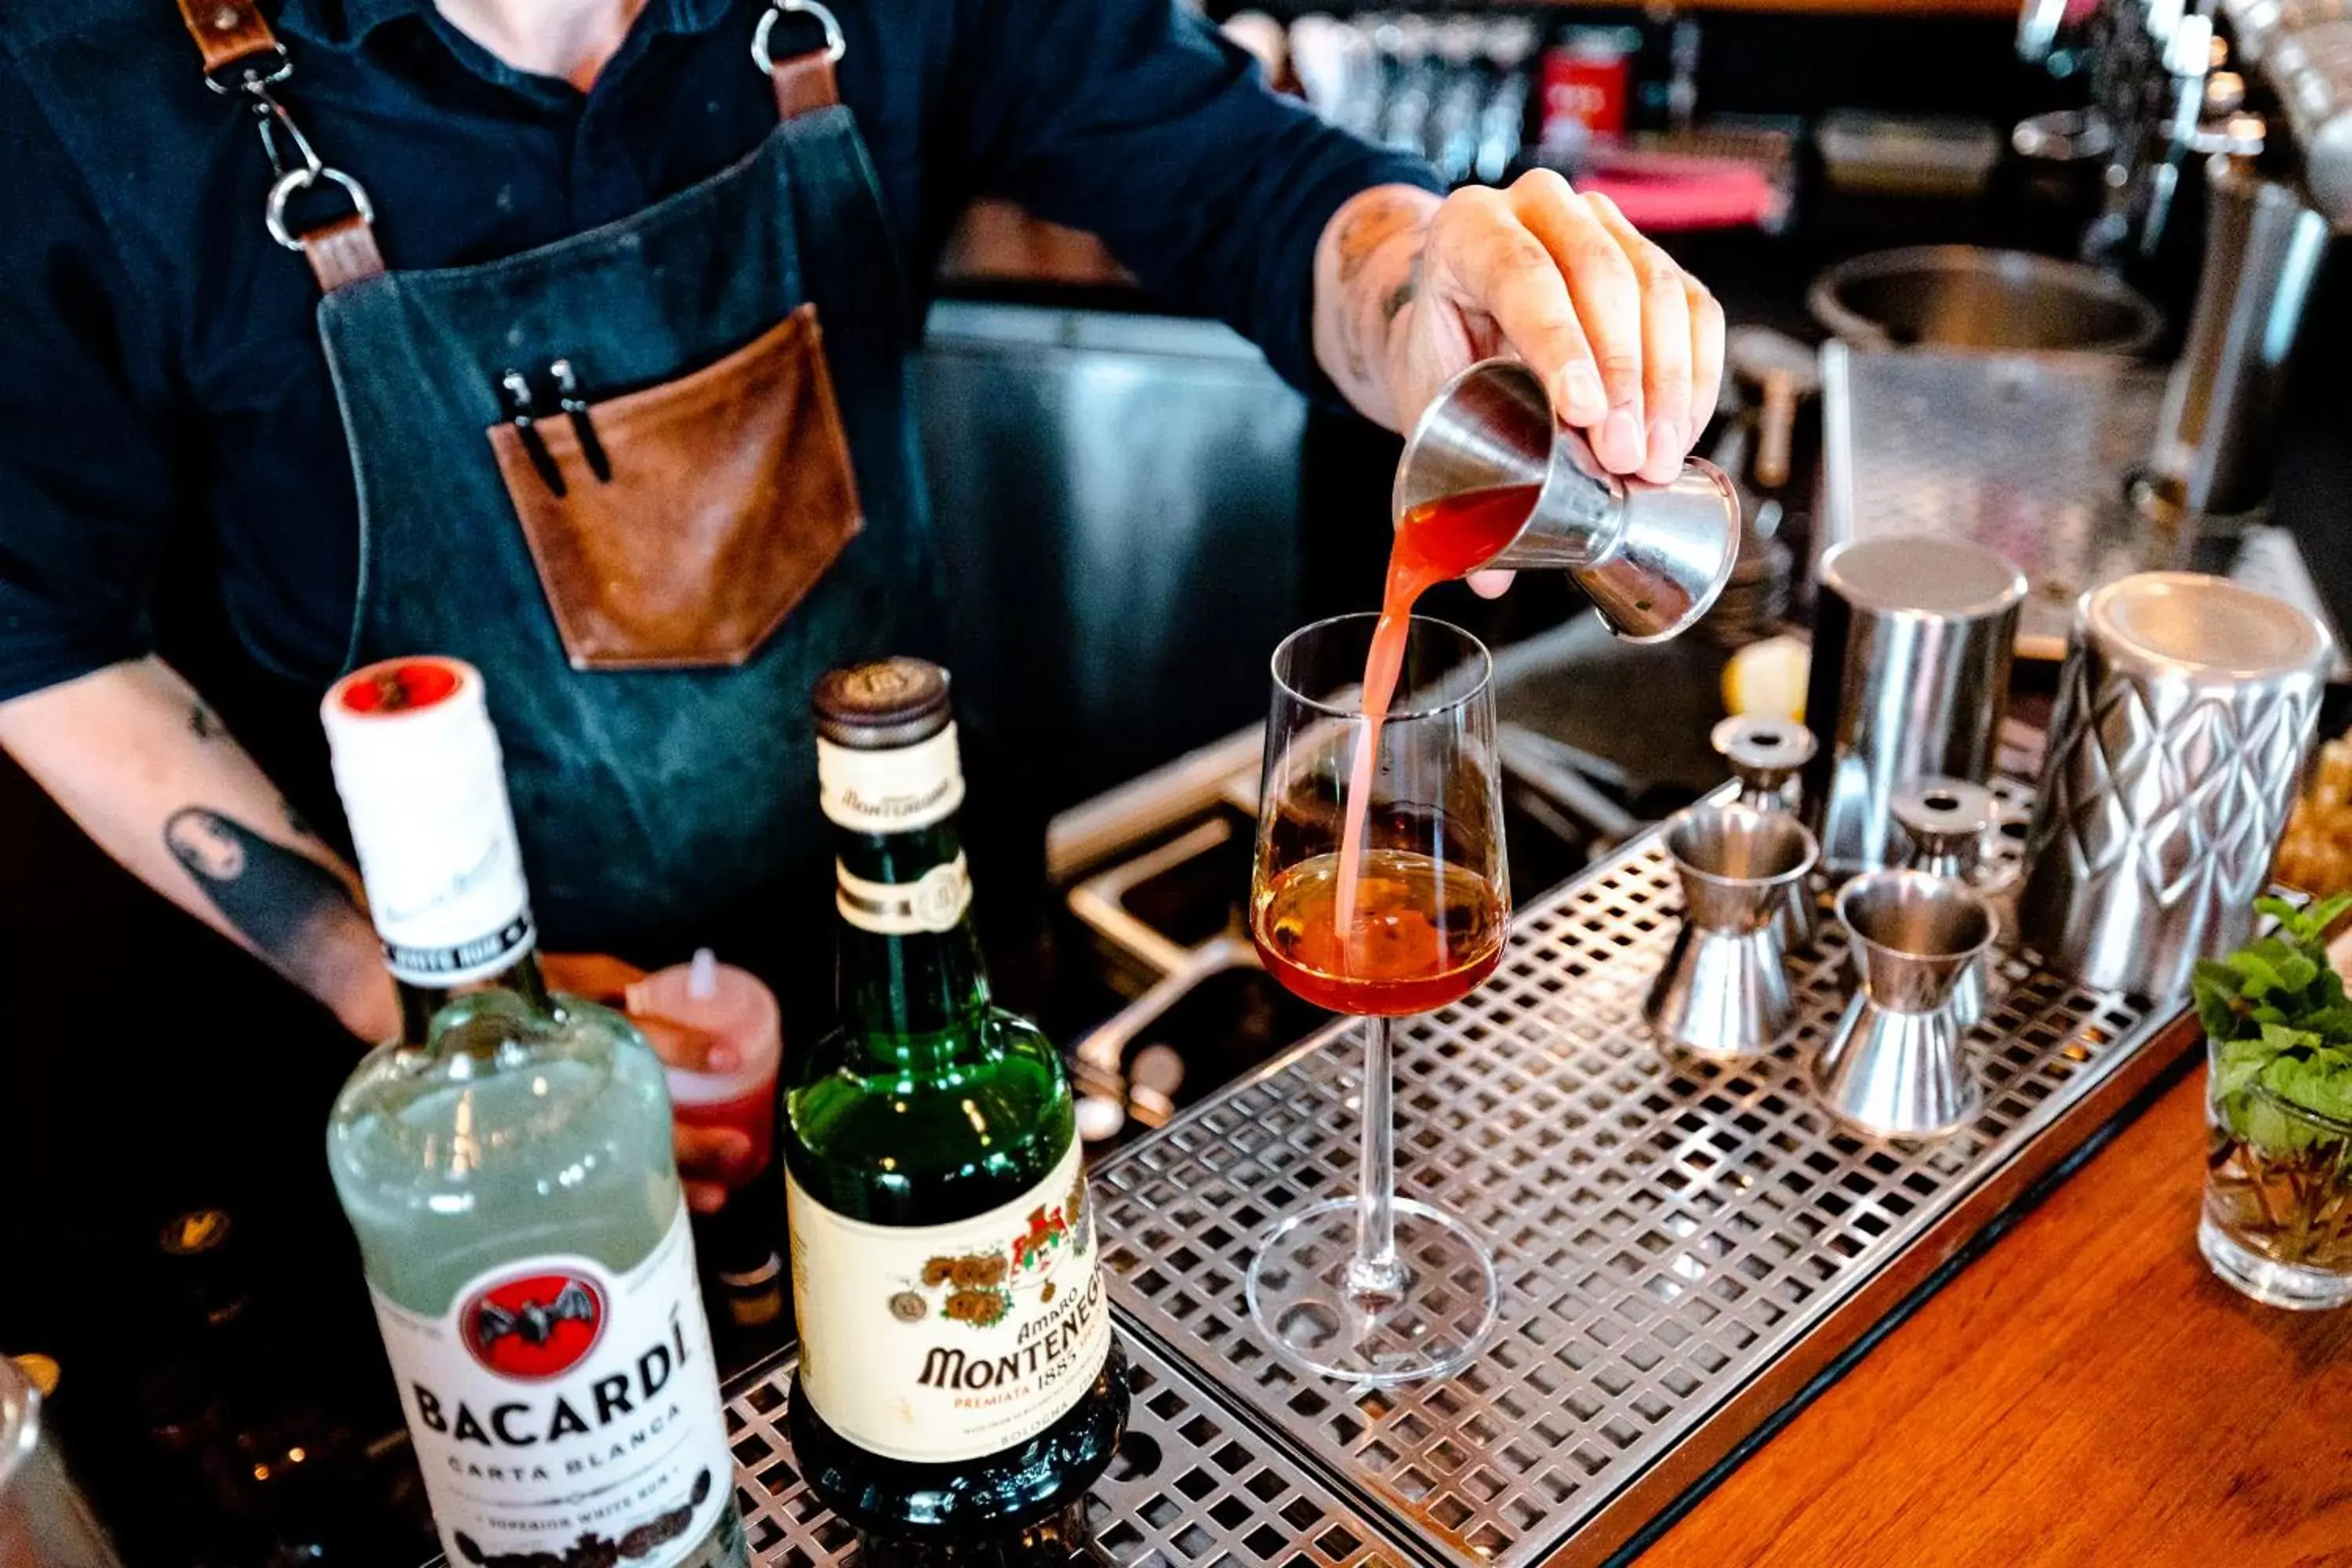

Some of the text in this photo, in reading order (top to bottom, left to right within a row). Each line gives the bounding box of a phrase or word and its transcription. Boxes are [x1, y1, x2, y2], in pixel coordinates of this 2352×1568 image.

[954, 1385, 1030, 1410] PREMIATA
[1039, 1350, 1077, 1390] 1885
[446, 1404, 682, 1483] CARTA BLANCA
[1000, 1402, 1069, 1448] BOLOGNA
[486, 1473, 670, 1531] SUPERIOR WHITE RUM
